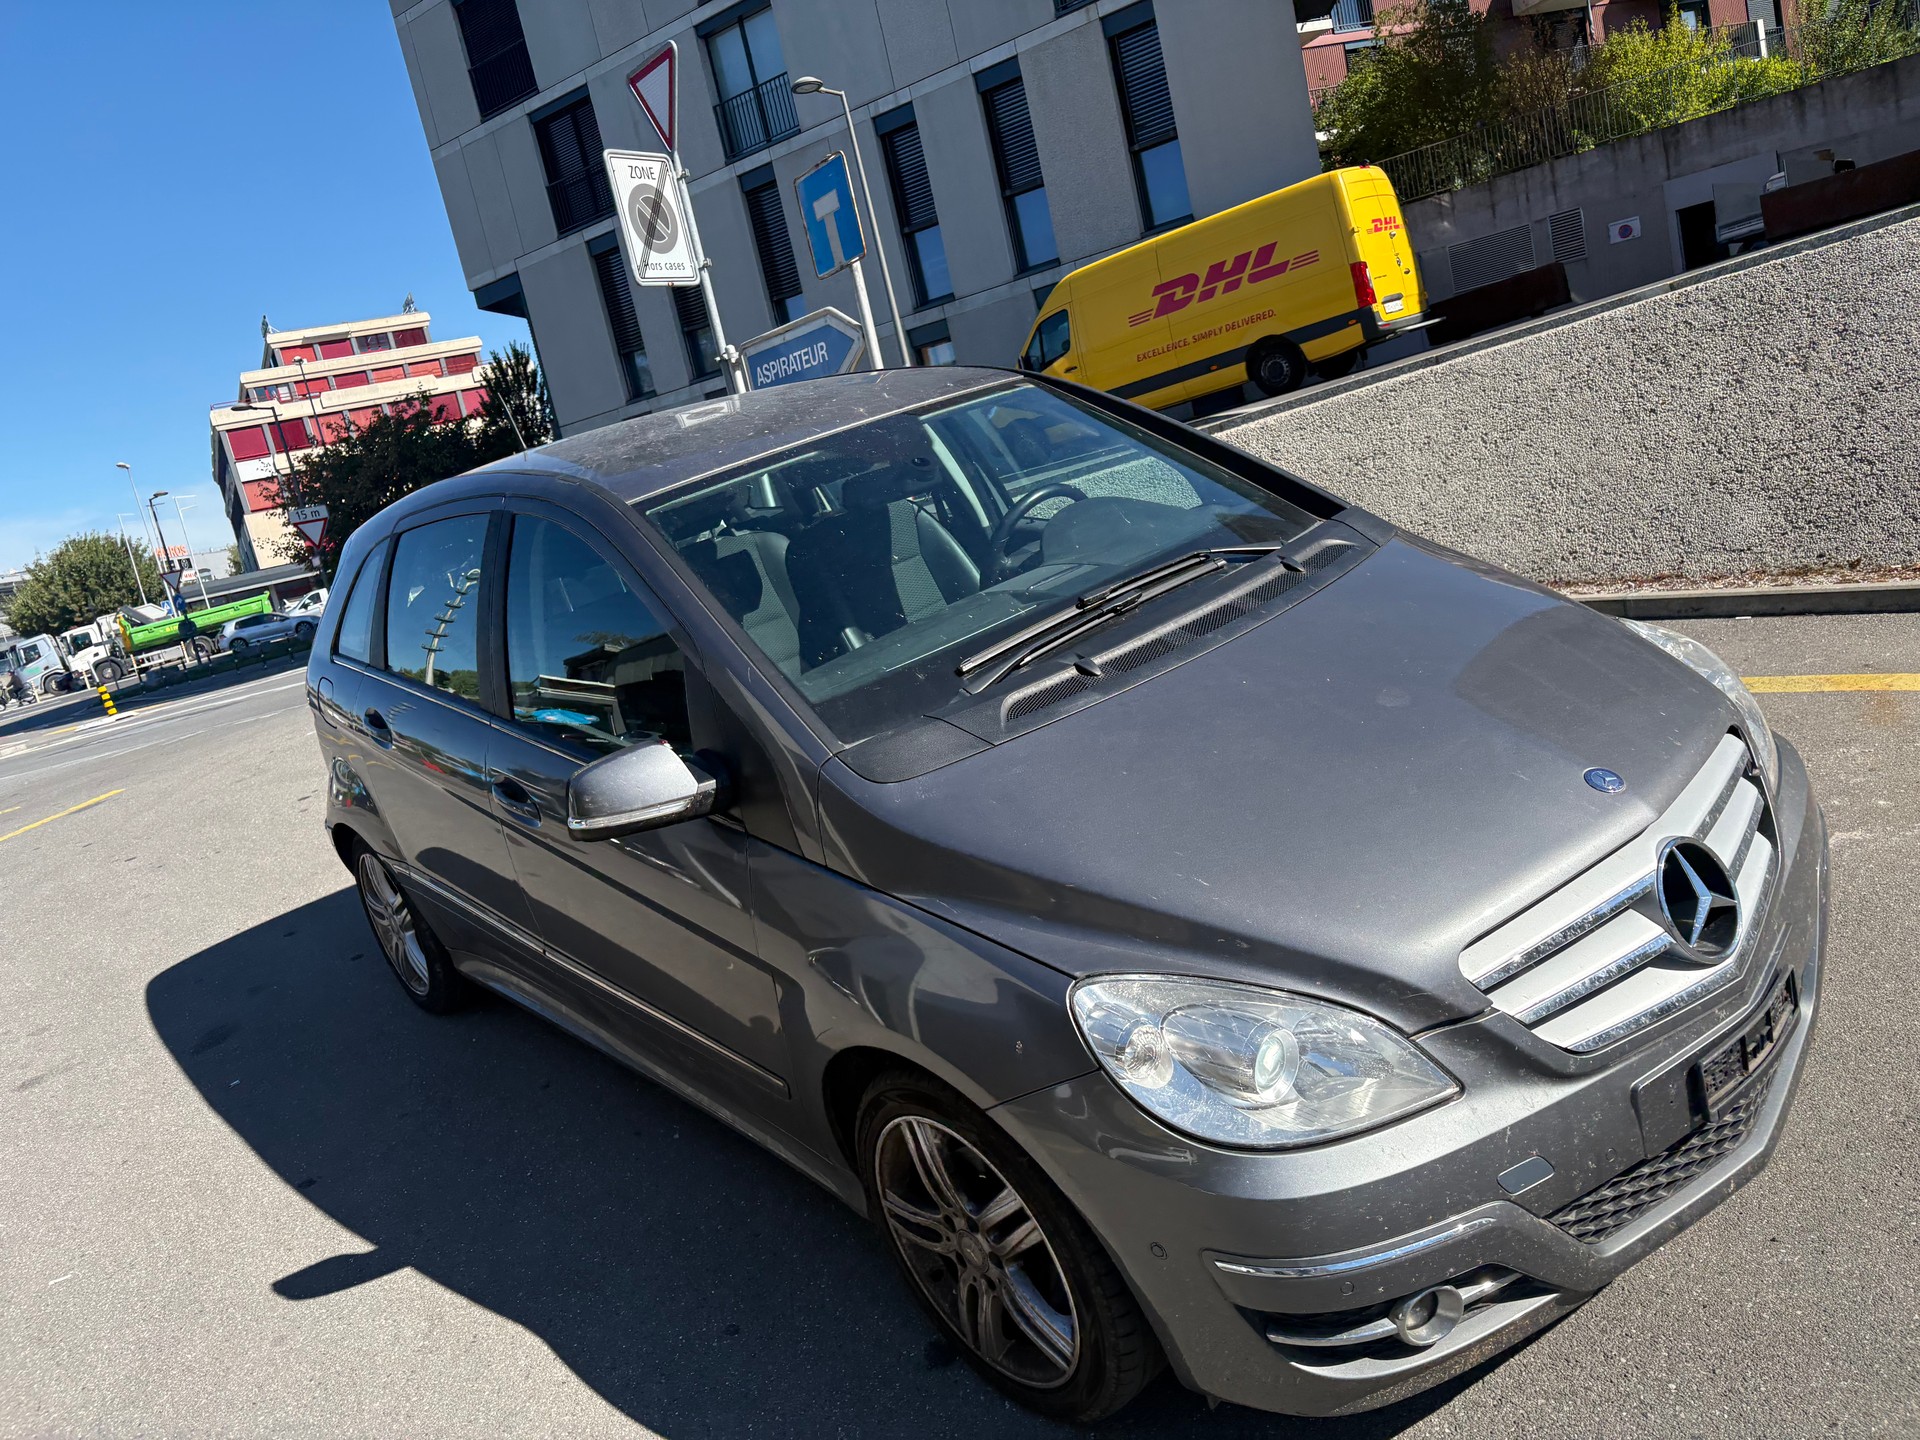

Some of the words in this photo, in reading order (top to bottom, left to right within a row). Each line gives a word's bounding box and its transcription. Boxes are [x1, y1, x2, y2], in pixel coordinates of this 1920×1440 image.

[627, 165, 657, 181] ZONE
[1371, 215, 1401, 233] DHL
[664, 262, 686, 271] cases
[1151, 240, 1291, 319] DHL
[1136, 338, 1191, 363] EXCELLENCE.
[1192, 325, 1224, 344] SIMPLY
[1225, 309, 1277, 333] DELIVERED.
[756, 341, 829, 387] ASPIRATEUR
[295, 509, 308, 521] 15
[310, 508, 321, 518] m
